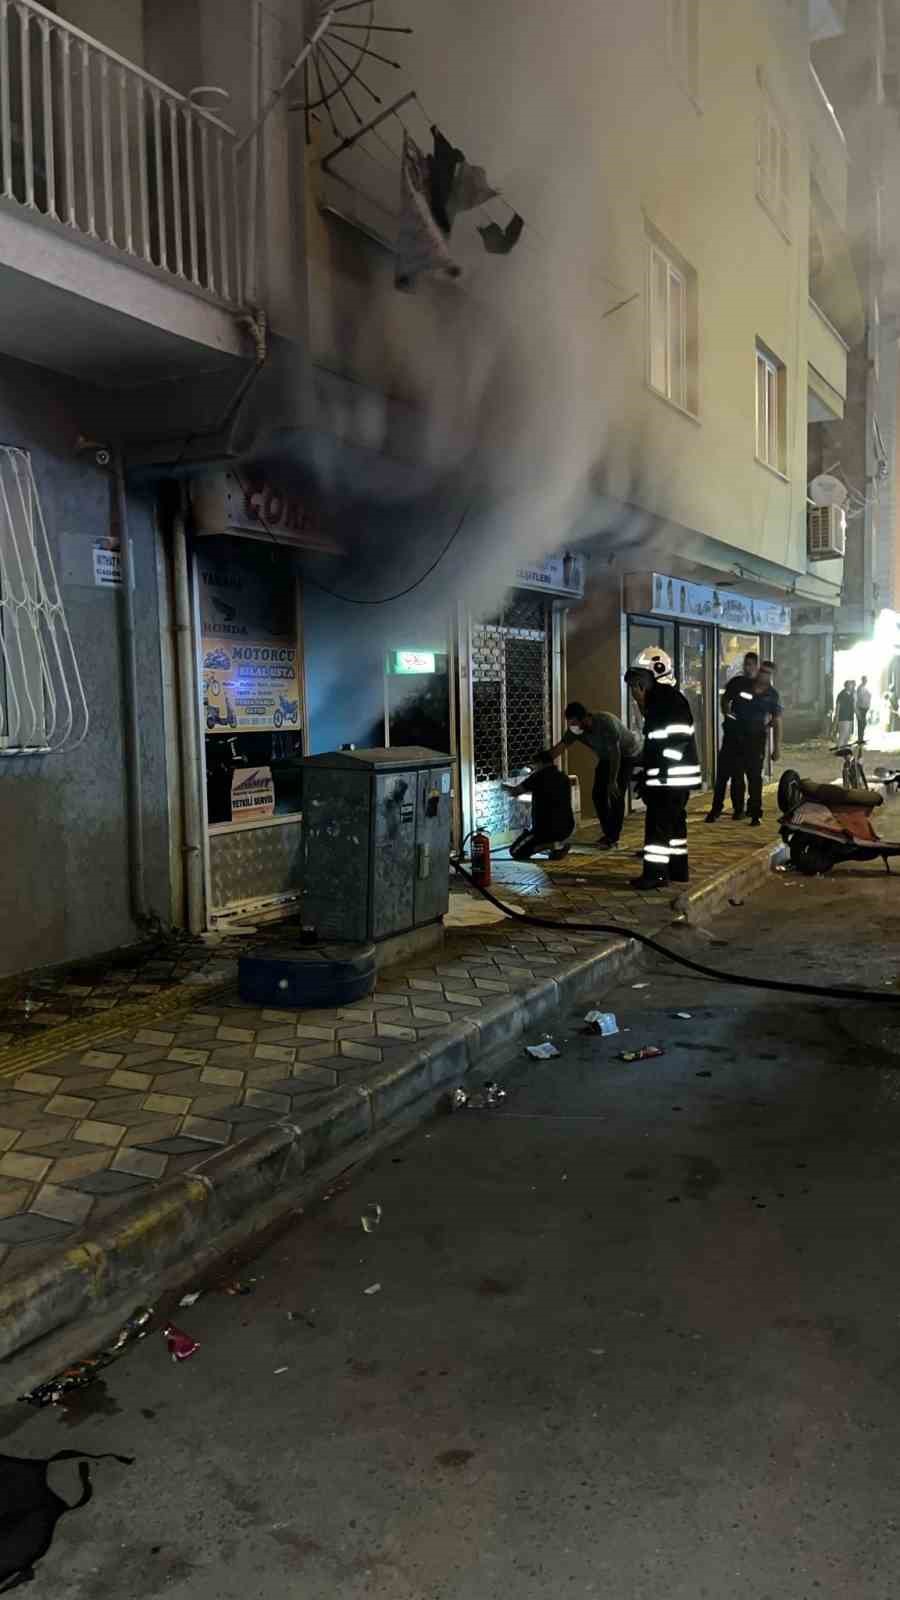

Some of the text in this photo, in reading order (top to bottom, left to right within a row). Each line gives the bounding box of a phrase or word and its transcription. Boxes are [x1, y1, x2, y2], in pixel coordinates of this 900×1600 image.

[203, 624, 248, 635] HONDA
[231, 647, 296, 662] MOTORCU
[270, 666, 295, 679] USTA
